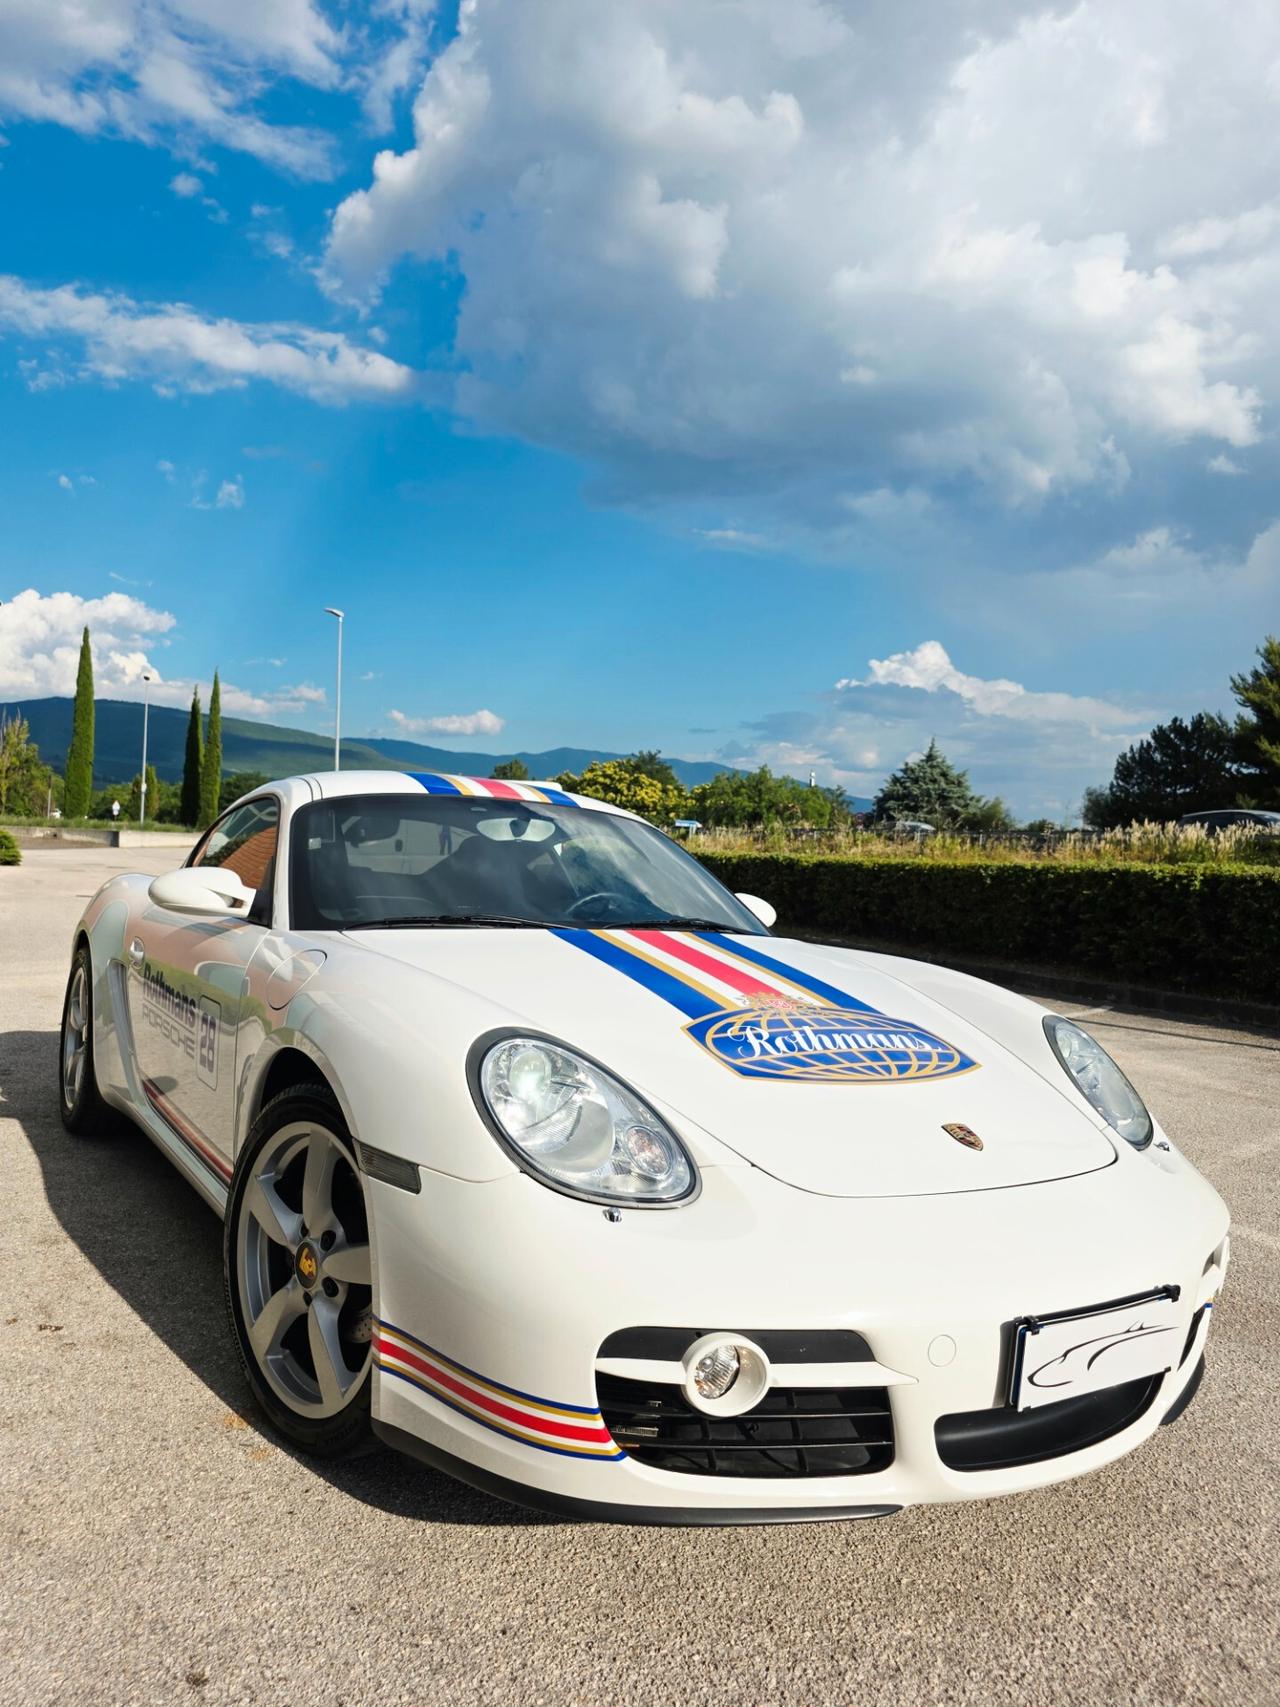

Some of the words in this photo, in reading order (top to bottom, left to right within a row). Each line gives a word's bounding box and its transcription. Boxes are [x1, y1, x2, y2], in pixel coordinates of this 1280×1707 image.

[143, 962, 196, 1029] Rothmans
[142, 1002, 195, 1060] PORSCHE
[200, 1012, 217, 1073] 28
[727, 1025, 941, 1058] Rothmans
